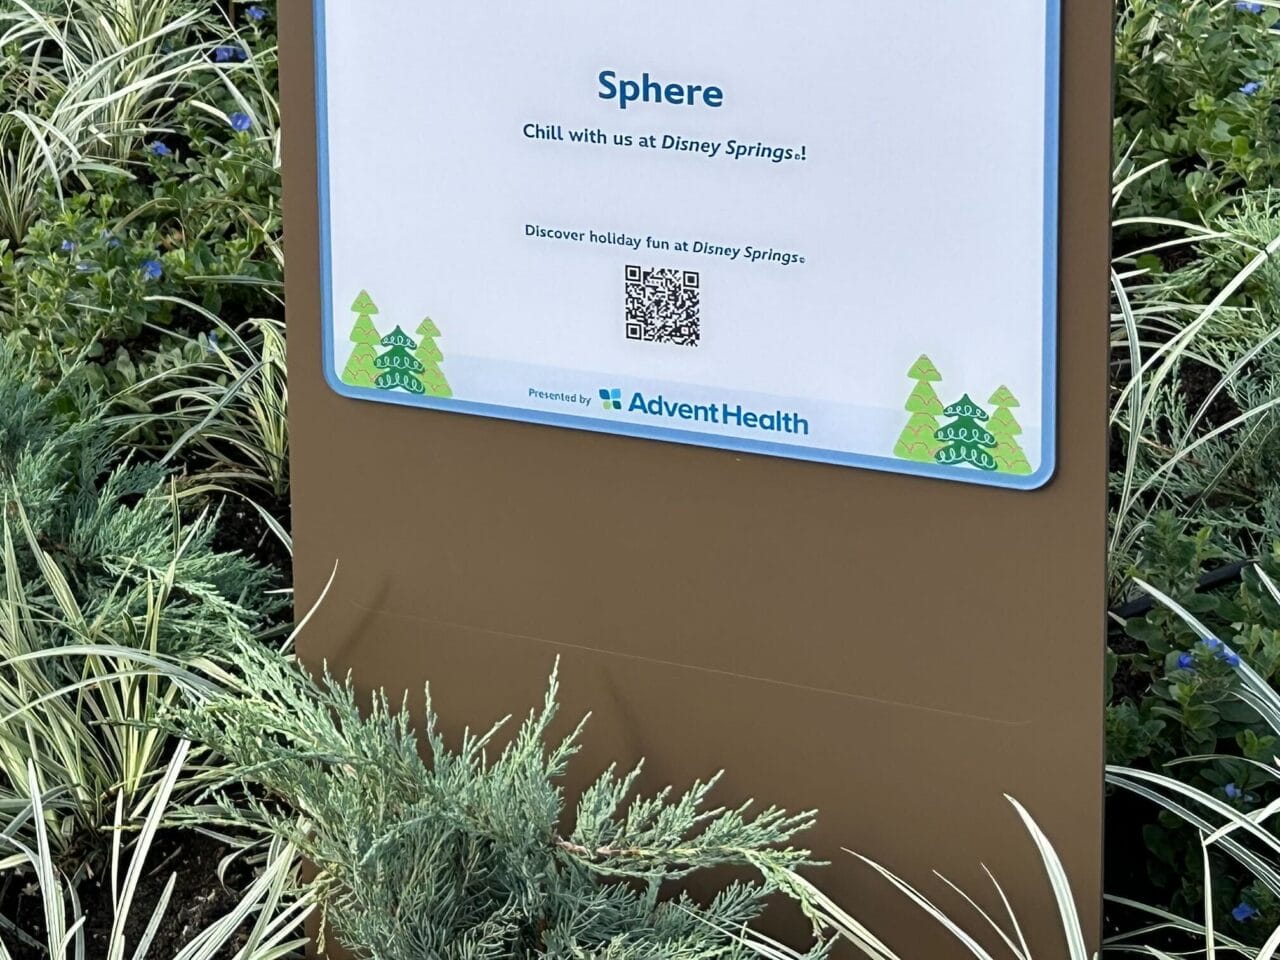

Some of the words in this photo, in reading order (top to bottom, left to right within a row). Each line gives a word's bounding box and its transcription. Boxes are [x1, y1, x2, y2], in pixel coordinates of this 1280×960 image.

[598, 70, 724, 110] Sphere
[522, 123, 564, 141] Chill
[568, 127, 608, 145] with
[613, 134, 633, 147] us
[638, 135, 657, 149] at
[661, 134, 722, 158] Disney
[524, 223, 586, 242] Discover
[589, 229, 642, 251] holiday
[645, 235, 670, 251] fun
[673, 240, 689, 253] at
[692, 240, 741, 260] Disney
[528, 387, 577, 403] Presented
[579, 393, 592, 407] by
[627, 391, 809, 435] AdventHealth
